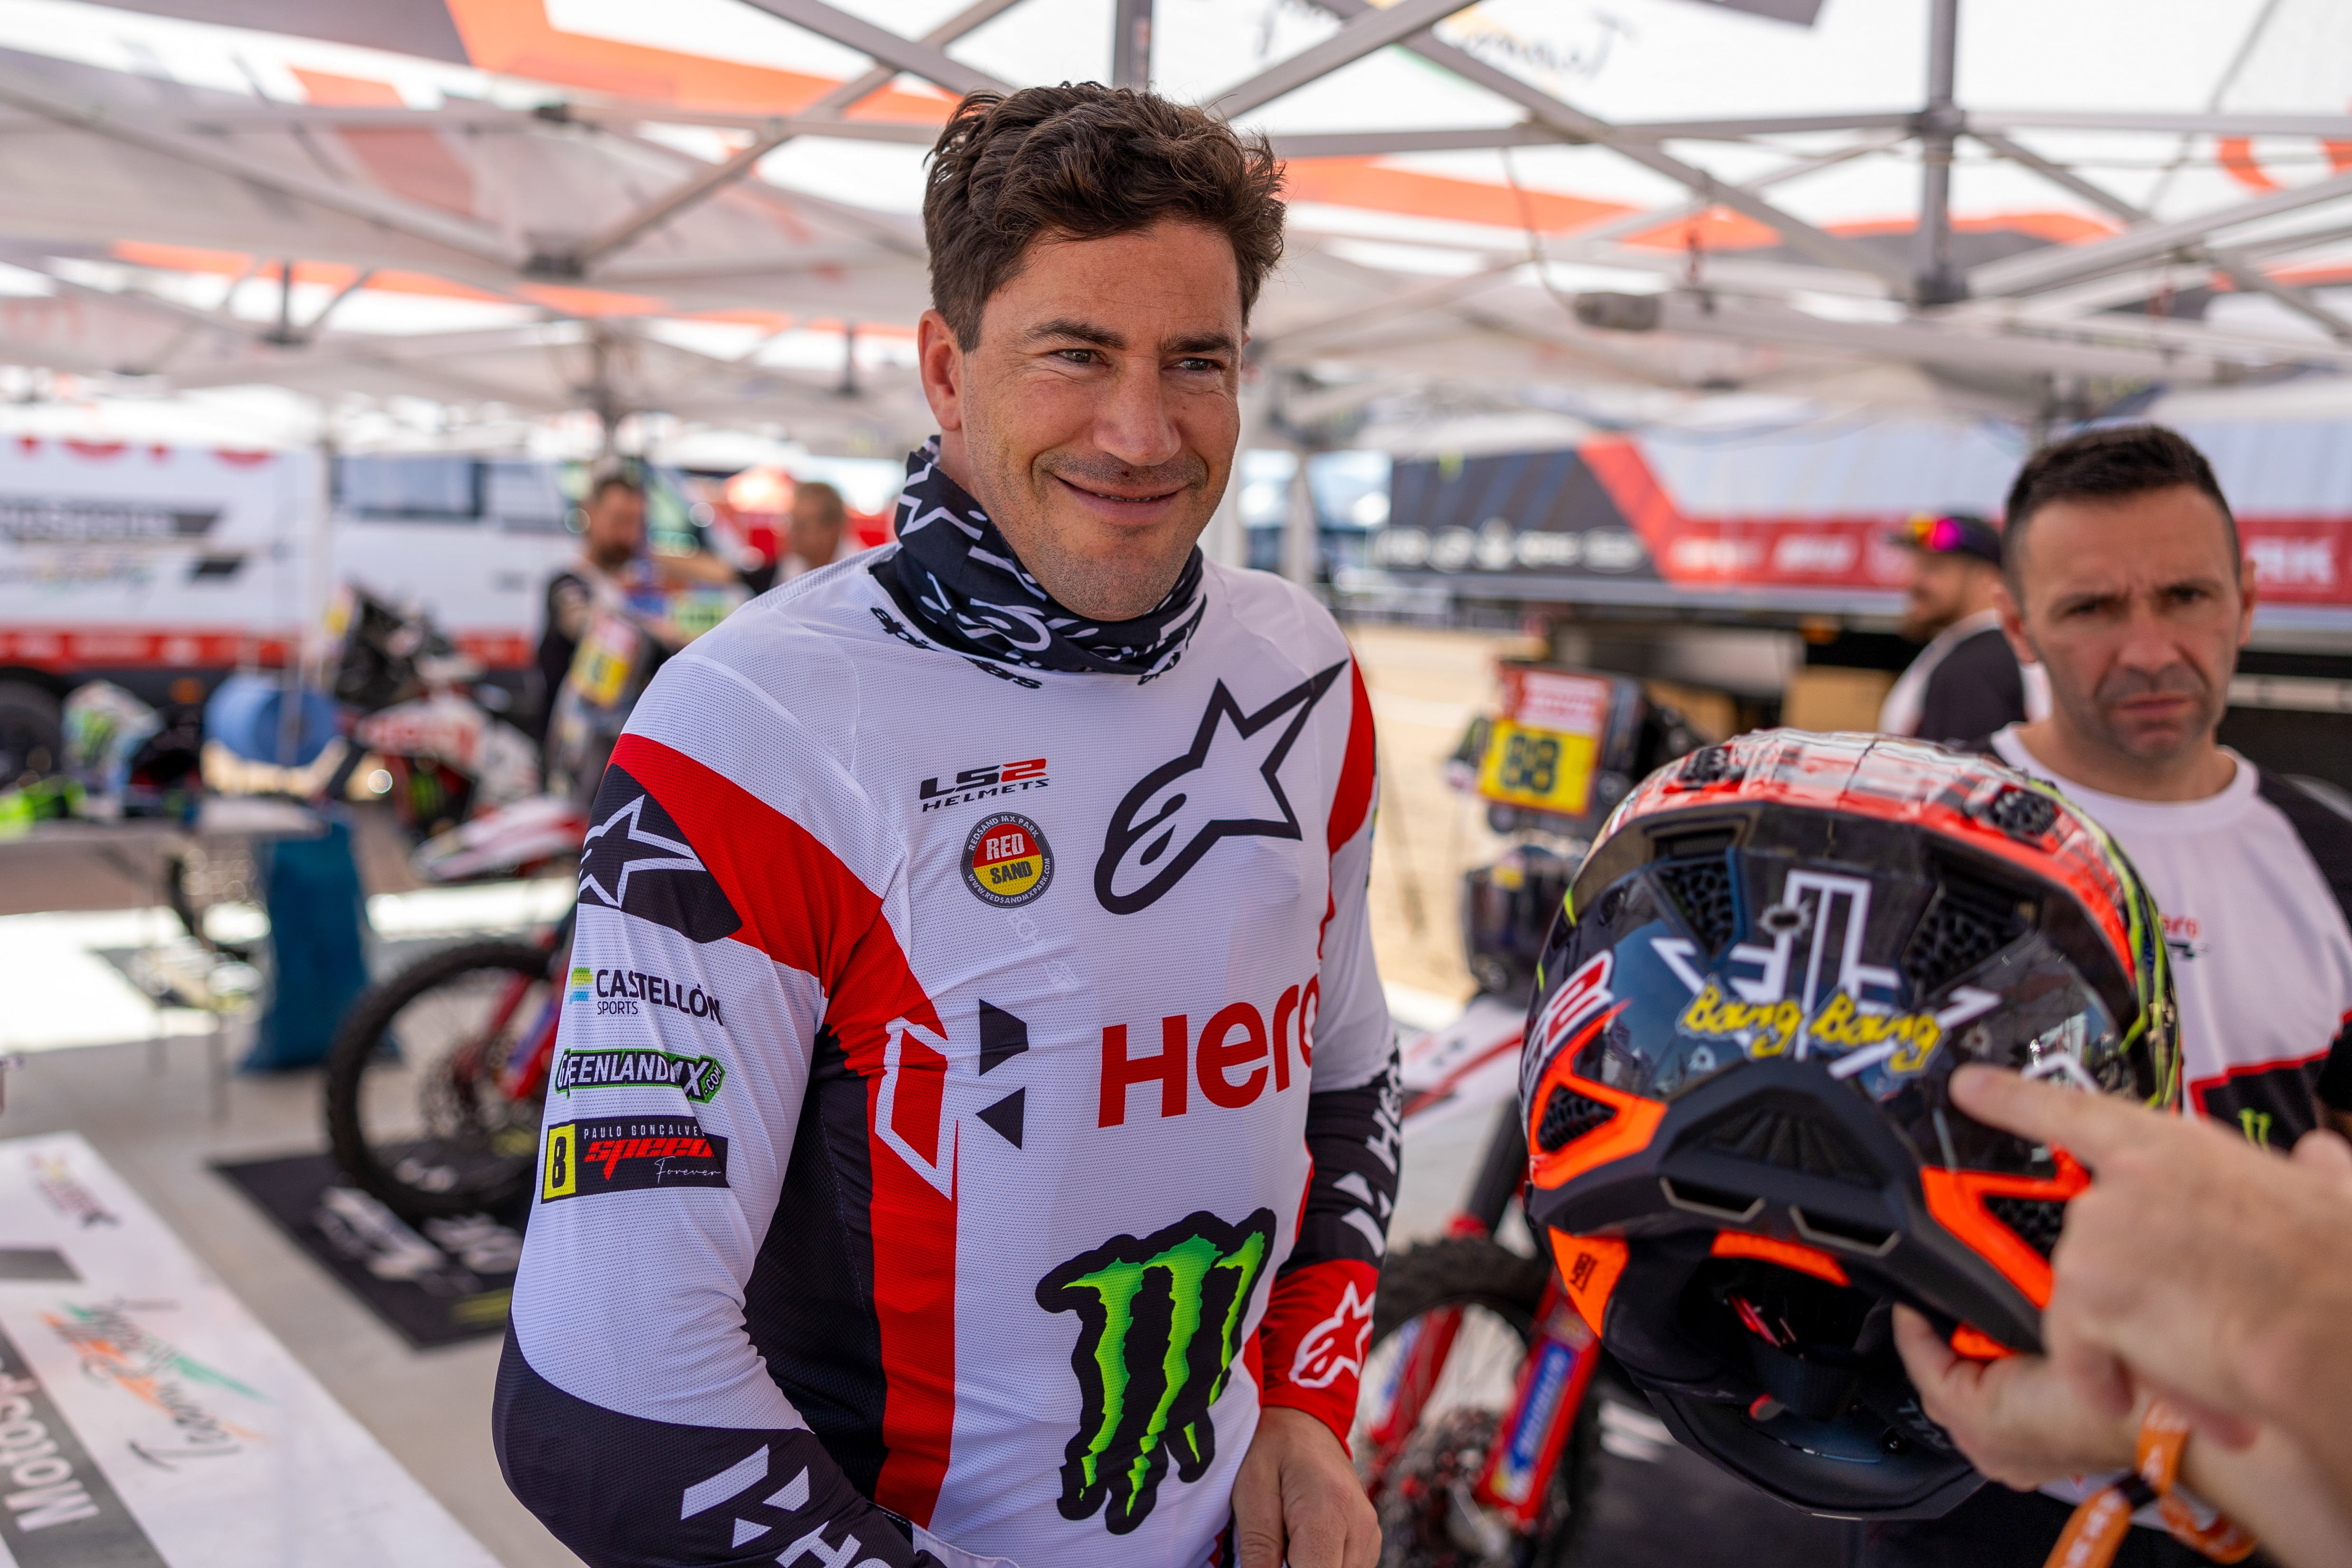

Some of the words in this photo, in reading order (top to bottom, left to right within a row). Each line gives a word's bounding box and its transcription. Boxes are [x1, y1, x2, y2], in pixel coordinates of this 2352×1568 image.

[919, 758, 1047, 800] LS2
[923, 779, 1049, 812] HELMETS
[968, 818, 999, 851] REDSAND
[1018, 818, 1039, 838] PARK
[986, 833, 1025, 861] RED
[968, 858, 1050, 903] WWW.REDSANDMXPARK.COM
[990, 861, 1033, 884] SAND
[596, 969, 724, 1026] CASTELLÓN
[597, 1001, 638, 1015] SPORTS
[1680, 983, 1803, 1058] Bang
[1809, 992, 1942, 1072] Bang
[584, 1126, 621, 1140] PAULO
[632, 1124, 704, 1137] GONÇALVE
[552, 1136, 566, 1188] 8
[654, 1156, 721, 1184] Forever
